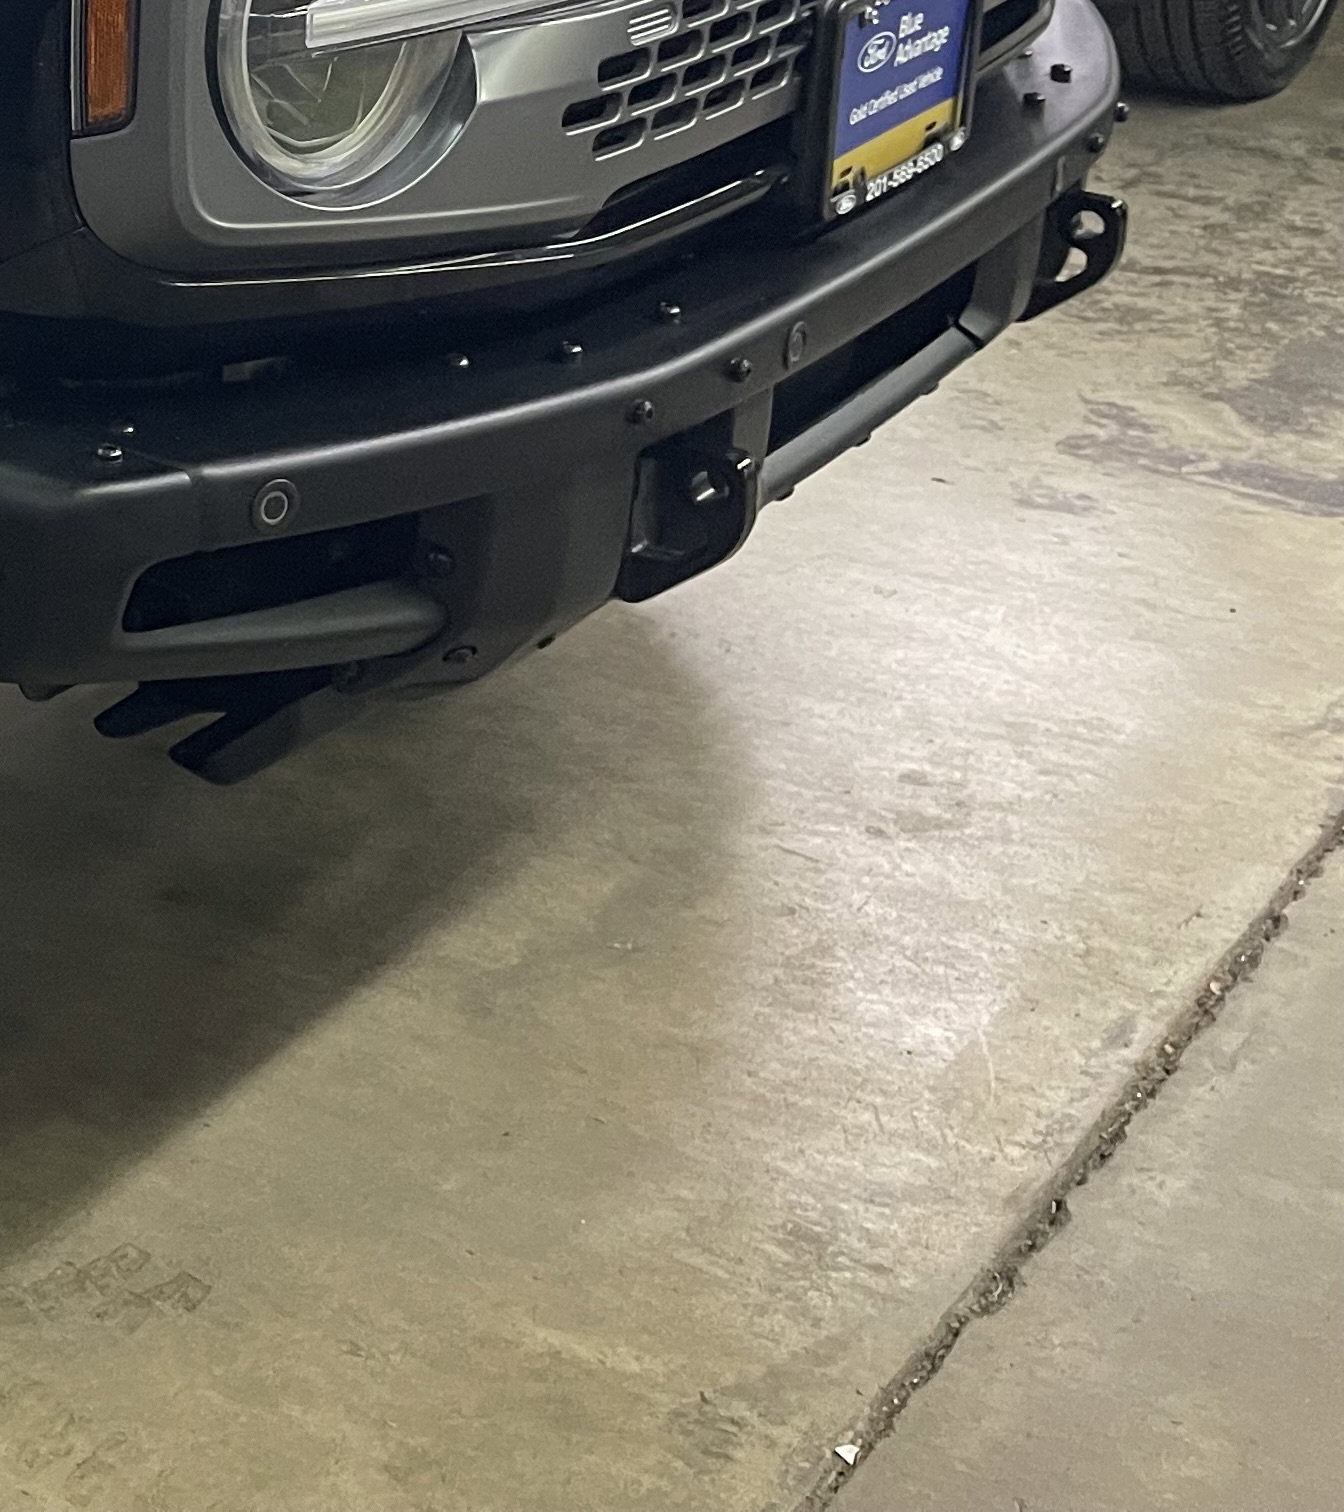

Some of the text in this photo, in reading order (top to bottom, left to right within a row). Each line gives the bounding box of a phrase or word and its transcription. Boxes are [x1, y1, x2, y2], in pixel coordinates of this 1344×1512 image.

[898, 12, 924, 38] Blue
[861, 36, 892, 70] Ford
[894, 26, 950, 67] Advantage
